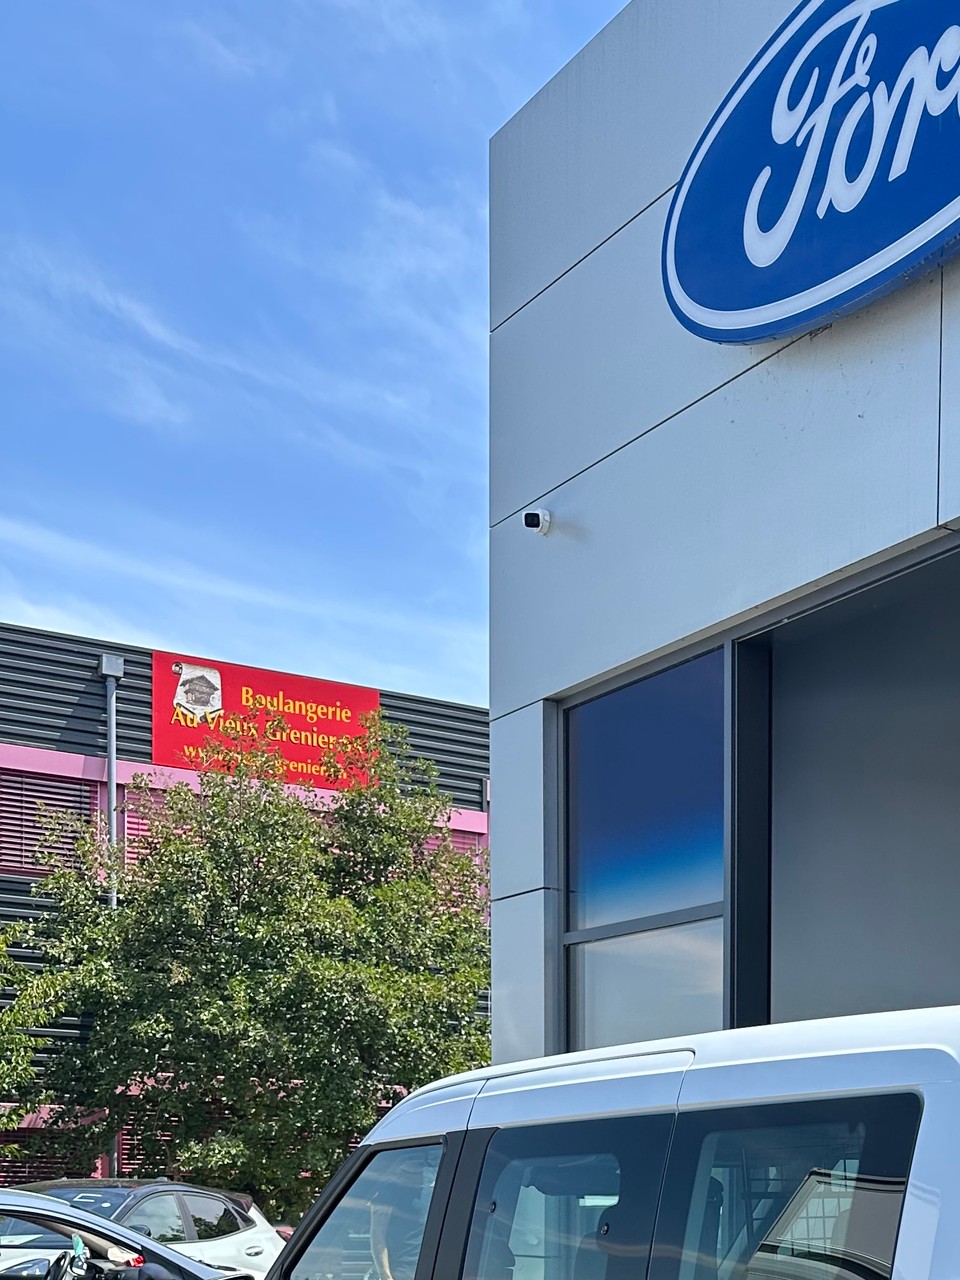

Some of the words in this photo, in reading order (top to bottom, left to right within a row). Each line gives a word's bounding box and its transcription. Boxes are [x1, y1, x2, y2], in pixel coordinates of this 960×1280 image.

[241, 686, 352, 723] Boulangerie
[171, 706, 197, 728] Au
[264, 719, 337, 749] Grenier
